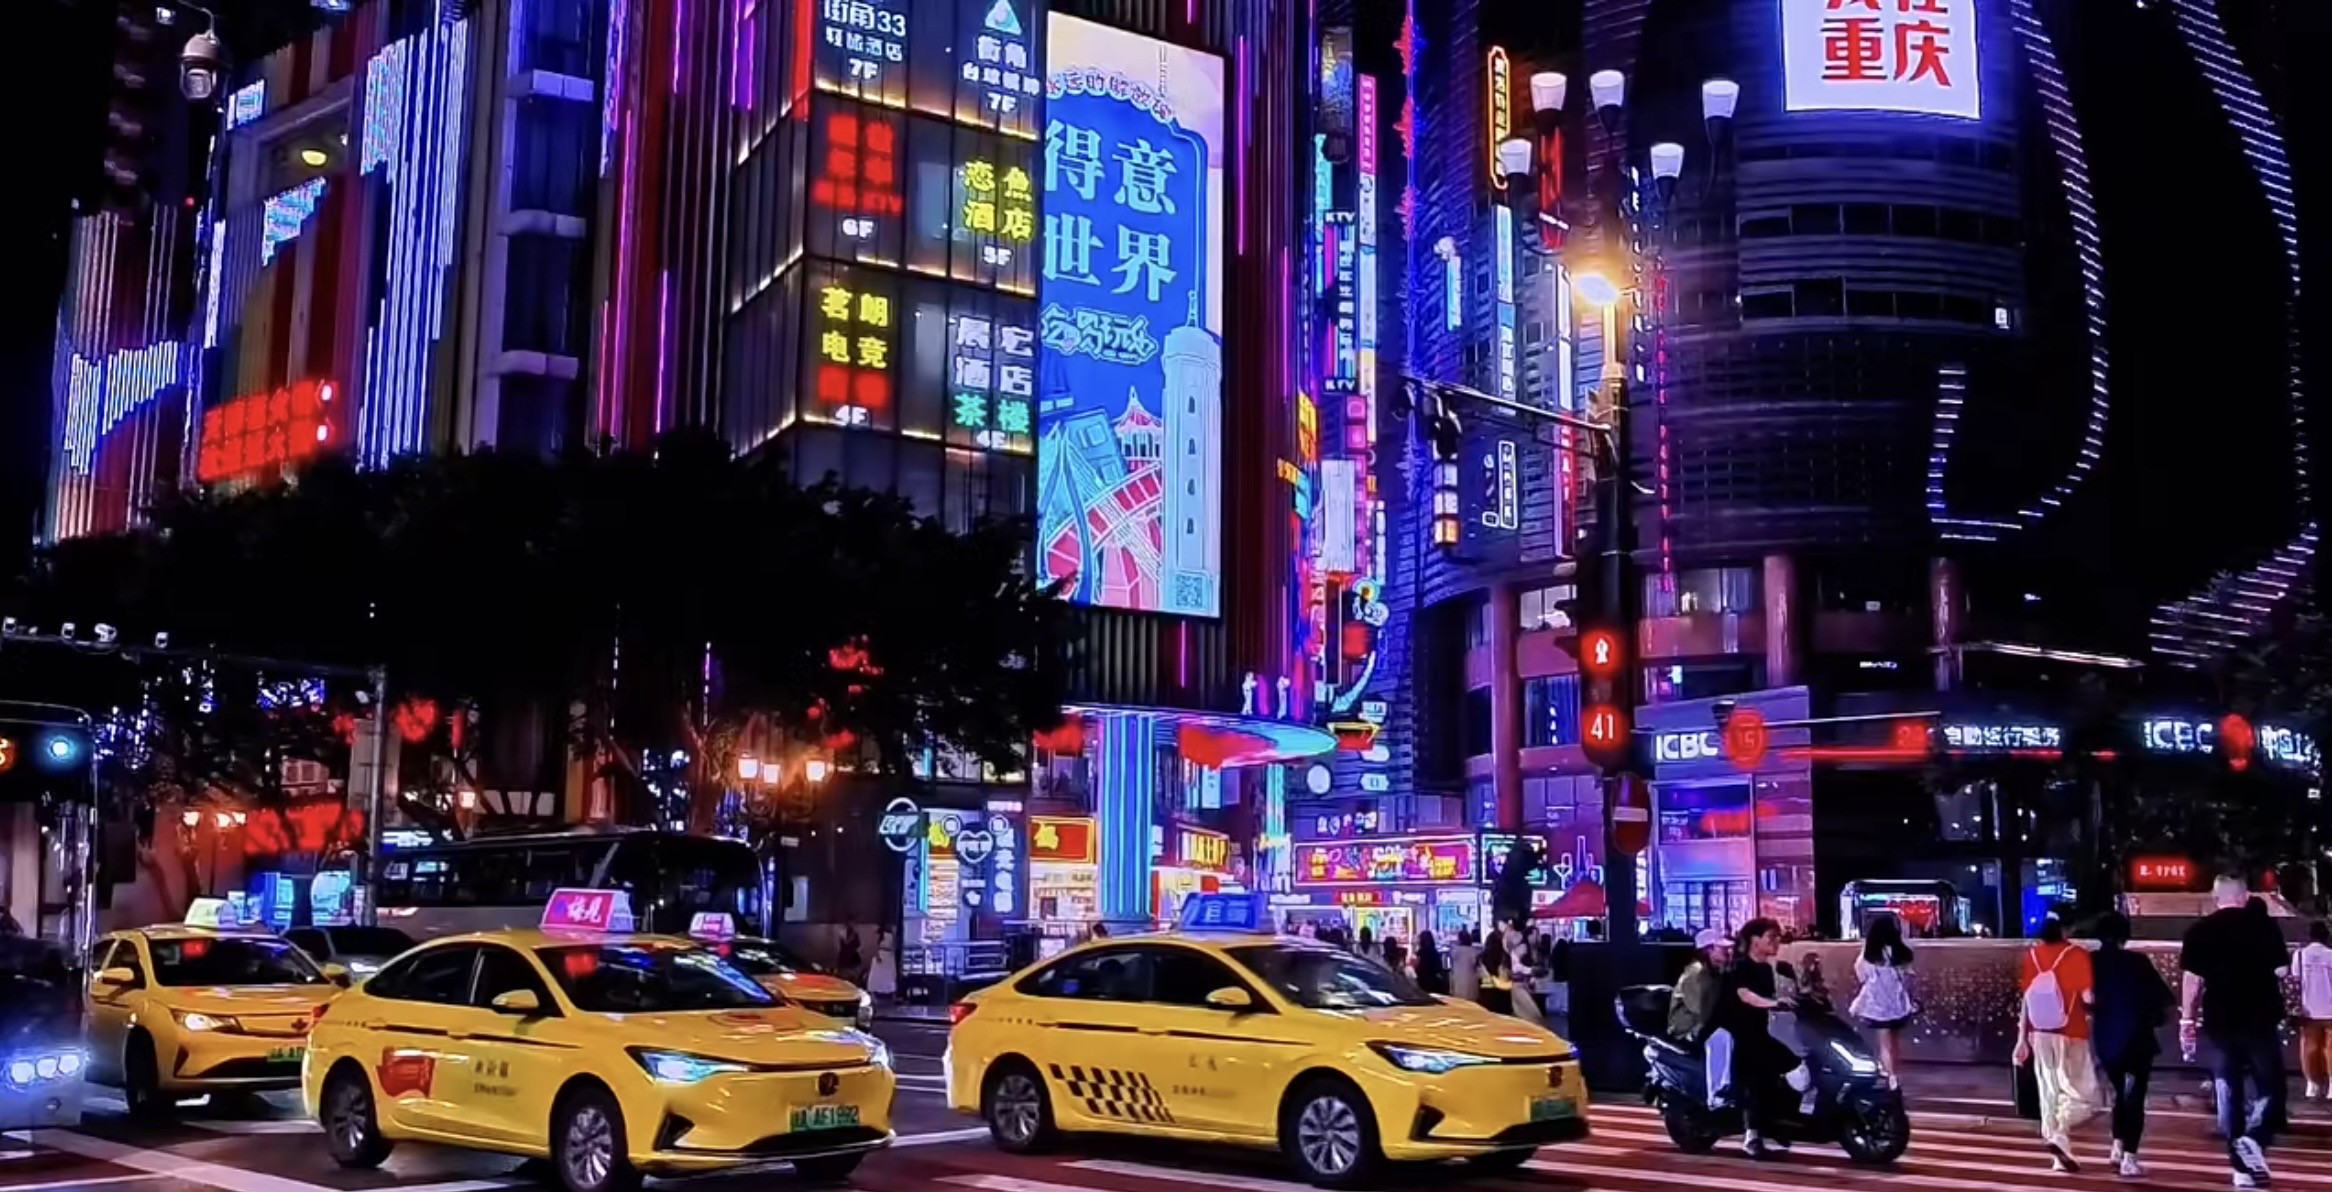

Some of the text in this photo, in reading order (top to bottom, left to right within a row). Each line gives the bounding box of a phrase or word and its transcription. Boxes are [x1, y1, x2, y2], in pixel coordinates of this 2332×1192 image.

[1820, 17, 1952, 87] 重庆
[849, 58, 879, 79] 7F
[987, 92, 1016, 112] 7F
[1045, 119, 1178, 215] 得意
[842, 218, 874, 238] 6F
[963, 200, 1034, 240] 酒店
[1326, 212, 1355, 223] KTV
[1043, 213, 1177, 301] 世界
[822, 330, 887, 369] 电竞
[954, 356, 1032, 396] 酒店
[1325, 379, 1355, 391] KTV
[835, 404, 868, 427] 4F
[954, 394, 1029, 434] 茶楼
[1591, 712, 1614, 740] 41
[1656, 732, 1719, 761] ICBC
